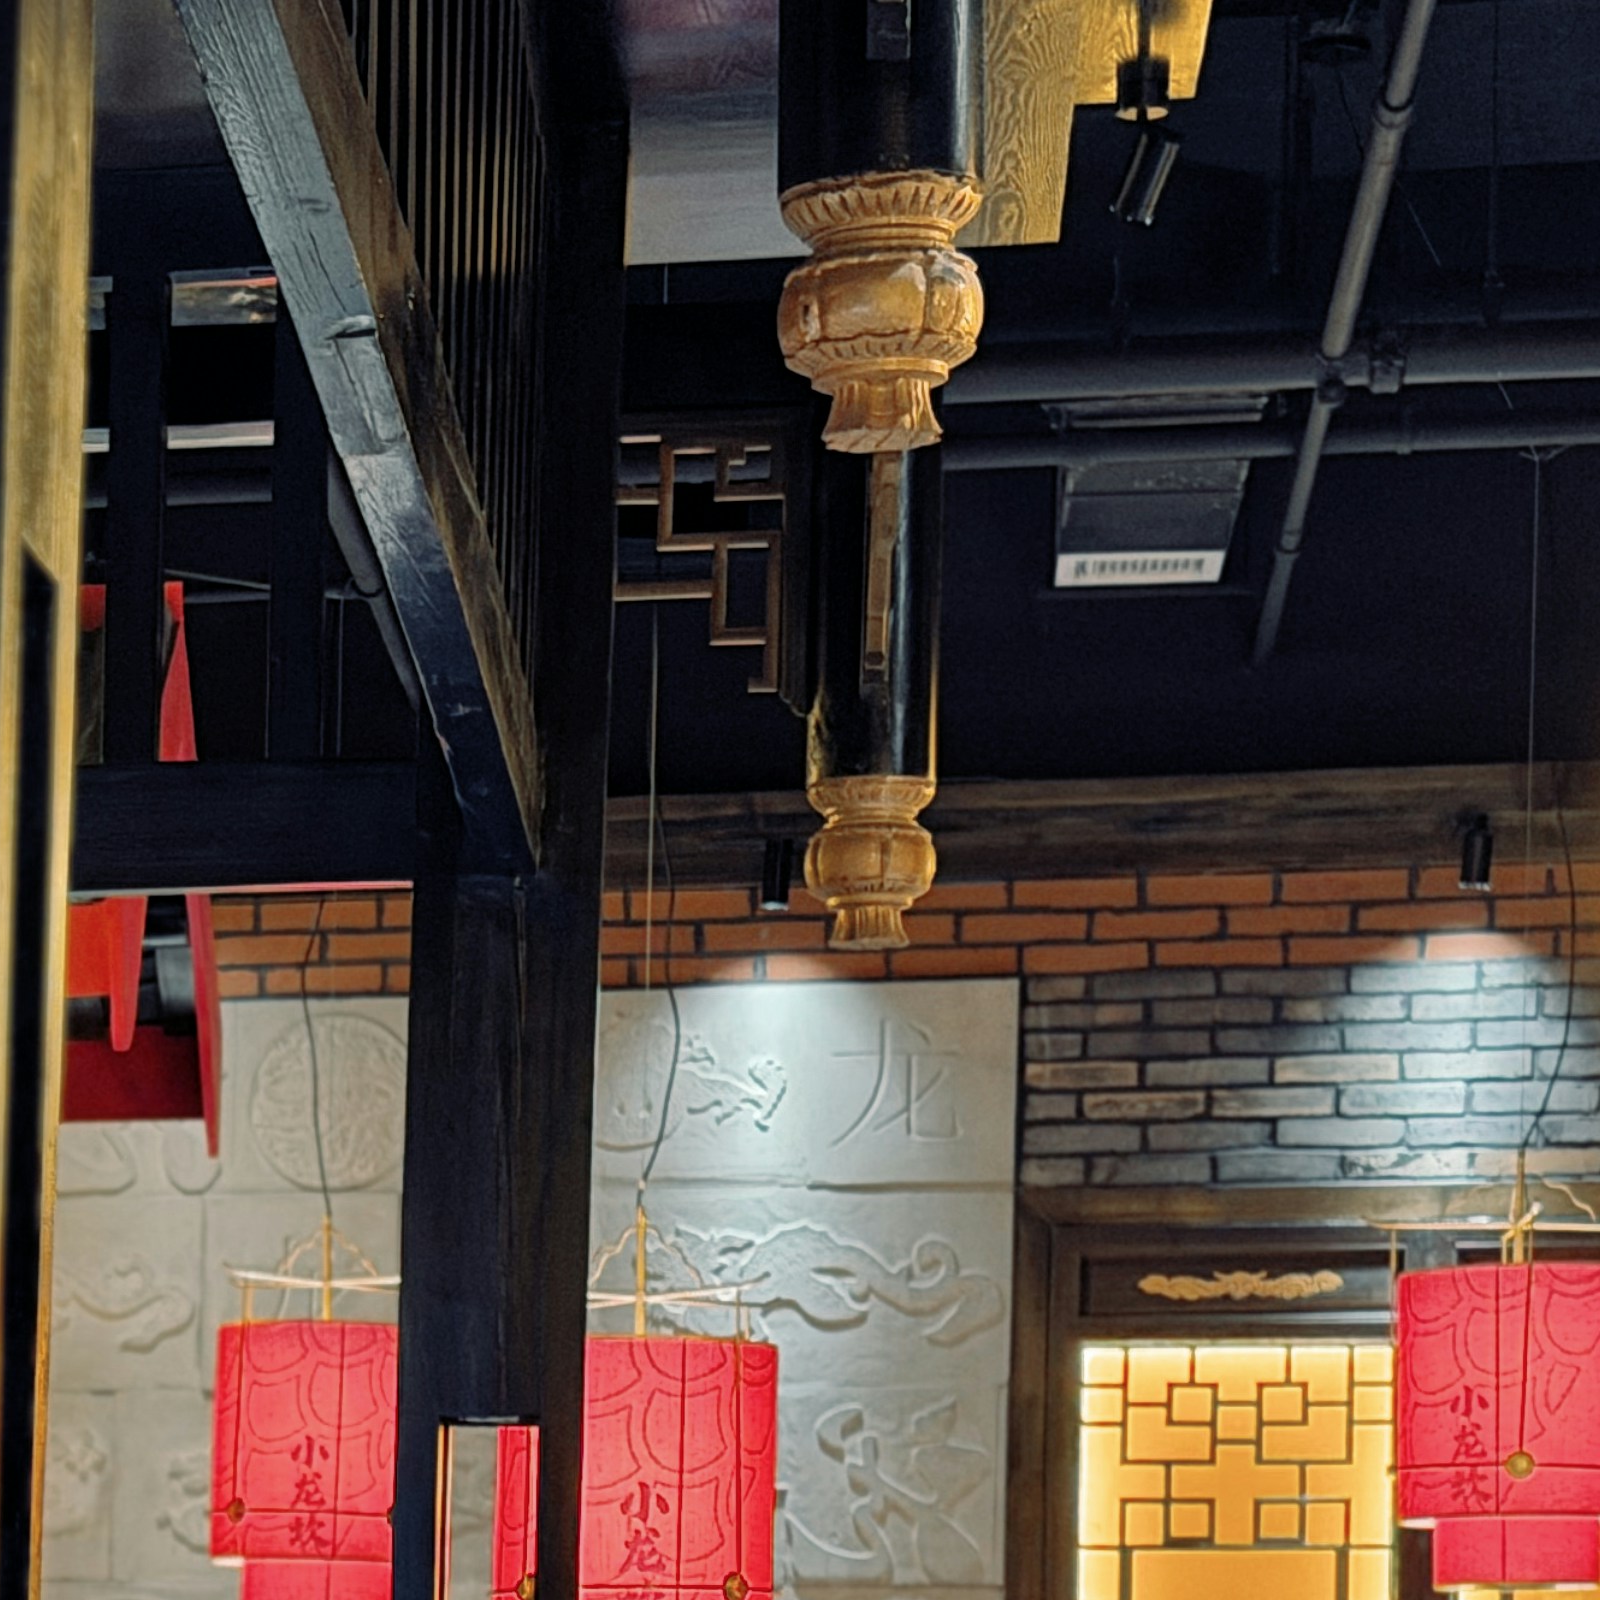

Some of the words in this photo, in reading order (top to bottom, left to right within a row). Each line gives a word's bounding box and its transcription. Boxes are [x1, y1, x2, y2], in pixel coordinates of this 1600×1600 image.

[288, 1434, 335, 1550] 小龙坎
[1450, 1385, 1493, 1502] 小龙坎
